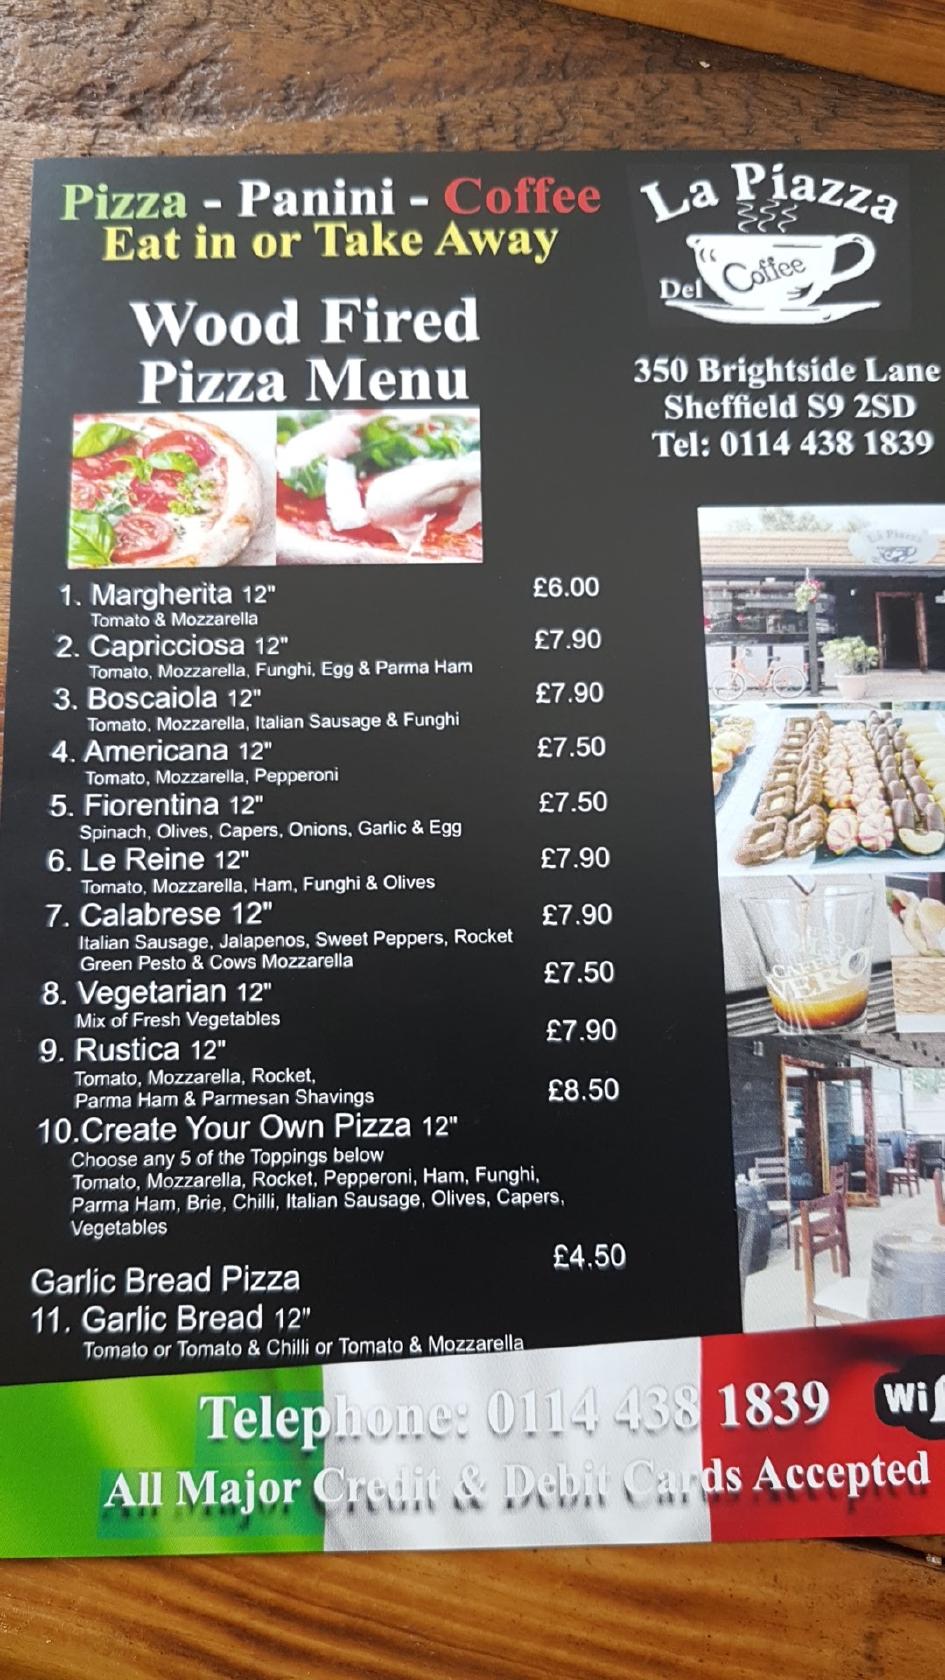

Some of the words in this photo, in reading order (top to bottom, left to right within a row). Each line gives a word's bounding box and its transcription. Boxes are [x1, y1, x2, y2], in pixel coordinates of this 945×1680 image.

[60, 180, 188, 221] Pizza
[238, 178, 395, 217] Panini
[444, 176, 602, 215] Coffee
[640, 179, 720, 224] La
[730, 162, 899, 225] Piazza
[102, 224, 180, 261] Eat
[194, 222, 237, 259] in
[252, 231, 301, 259] or
[314, 221, 423, 258] Take
[435, 220, 559, 264] Away
[722, 256, 807, 293] Coffee
[659, 278, 704, 299] Del
[129, 297, 301, 347] Wood
[320, 294, 480, 344] Fired
[138, 359, 288, 405] Pizza
[305, 357, 469, 402] Menu
[633, 357, 689, 383] 350
[697, 355, 857, 389] Brightside
[864, 356, 942, 383] Lane
[663, 394, 799, 420] Sheffield
[807, 394, 846, 419] S9
[853, 394, 918, 419] 2SD
[651, 430, 711, 458] Tel:
[719, 430, 792, 457] 0114
[799, 429, 855, 456] 438
[863, 429, 936, 456] 1839
[90, 580, 233, 611] Margherita
[533, 576, 600, 598] £6.00
[89, 612, 151, 628] Tomato
[170, 610, 259, 627] Mozzarella
[54, 634, 80, 659] 2.
[87, 632, 245, 662] Capricciosa
[534, 628, 602, 650] £7.90
[87, 663, 153, 681] Tomato,
[156, 662, 250, 679] Mozzarella,
[255, 661, 316, 681] Funghi,
[320, 660, 354, 680] Egg
[374, 659, 430, 676] Parma
[433, 658, 473, 675] Ham
[86, 684, 218, 711] Boscaiola
[535, 682, 604, 704] £7.90
[85, 716, 152, 733] Tomato,
[156, 715, 250, 732] Mozzarella,
[254, 714, 305, 730] Italian
[308, 712, 382, 732] Sausage
[403, 710, 460, 731] Funghi
[80, 738, 229, 763] Americana
[537, 735, 607, 758] £7.50
[84, 770, 151, 787] Tomato,
[154, 768, 249, 786] Mozzarella,
[253, 766, 339, 787] Pepperoni
[47, 793, 74, 818] 5.
[83, 791, 220, 817] Fiorentina
[539, 790, 608, 814] £7.50
[79, 823, 152, 844] Spinach,
[155, 822, 214, 840] Olives,
[216, 821, 284, 842] Capers,
[287, 821, 353, 838] Onions,
[357, 819, 408, 837] Garlic
[429, 818, 463, 838] Egg
[80, 847, 117, 872] Le
[123, 846, 206, 872] Reine
[540, 846, 611, 869] £7.90
[79, 878, 148, 896] Tomato,
[150, 877, 248, 895] Mozzarella,
[252, 876, 298, 894] Ham,
[302, 875, 361, 895] Funghi
[382, 874, 436, 891] Olives
[44, 903, 70, 928] 7.
[78, 901, 222, 928] Calabrese
[542, 903, 613, 926] £7.90
[78, 934, 130, 951] Italian
[133, 933, 214, 954] Sausage,
[218, 932, 310, 952] Jalapenos,
[314, 930, 369, 948] Sweet
[373, 929, 449, 950] Peppers,
[453, 927, 514, 945] Rocket
[79, 955, 133, 972] Green
[136, 954, 187, 971] Pesto
[207, 953, 257, 971] Cows
[260, 952, 354, 970] Mozzarella
[543, 960, 616, 984] £7.50
[75, 977, 227, 1010] Vegetarian
[74, 1012, 107, 1029] Mix
[109, 1011, 129, 1029] of
[130, 1011, 181, 1028] Fresh
[184, 1010, 281, 1032] Vegetables
[546, 1018, 618, 1042] £7.90
[73, 1035, 180, 1063] Rustica
[73, 1070, 142, 1089] Tomato,
[146, 1067, 246, 1086] Mozzarella,
[250, 1066, 316, 1085] Rocket,
[548, 1077, 620, 1102] £8.50
[73, 1092, 132, 1110] Parma
[136, 1091, 179, 1109] Ham
[200, 1089, 290, 1107] Parmesan
[294, 1087, 375, 1108] Shavings
[184, 1114, 252, 1142] Your
[258, 1113, 325, 1141] Own
[334, 1111, 412, 1139] Pizza
[69, 1151, 138, 1169] Choose
[142, 1153, 176, 1172] any
[179, 1149, 192, 1167] 5
[194, 1148, 215, 1167] of
[217, 1148, 246, 1167] the
[249, 1147, 329, 1169] Toppings
[332, 1146, 385, 1164] below
[71, 1173, 141, 1192] Tomato,
[145, 1171, 246, 1191] Mozzarella,
[251, 1170, 318, 1188] Rocket,
[323, 1167, 418, 1190] Pepperoni,
[423, 1167, 470, 1186] Ham,
[475, 1164, 540, 1188] Funghi,
[70, 1196, 130, 1215] Parma
[134, 1194, 181, 1214] Ham,
[185, 1193, 227, 1213] Brie,
[232, 1192, 280, 1212] Chilli,
[285, 1191, 338, 1210] Italian
[343, 1190, 426, 1212] Sausage,
[430, 1189, 491, 1209] Olives,
[496, 1187, 565, 1209] Capers,
[69, 1218, 168, 1241] Vegetables
[553, 1243, 627, 1270] £4.50
[30, 1267, 117, 1297] Garlic
[124, 1264, 212, 1296] Bread
[221, 1264, 301, 1293] Pizza
[31, 1305, 71, 1334] 11.
[80, 1304, 168, 1335] Garlic
[176, 1302, 263, 1333] Bread
[82, 1340, 149, 1361] Tomato
[152, 1344, 173, 1360] or
[176, 1339, 243, 1359] Tomato
[266, 1337, 310, 1358] Chilli
[314, 1340, 334, 1357] or
[337, 1336, 404, 1356] Tomato
[428, 1333, 525, 1355] Mozzarella
[199, 1393, 470, 1451] Telephone:
[486, 1386, 600, 1435] 0114
[614, 1384, 699, 1431] 438
[718, 1379, 831, 1428] 1839
[103, 1471, 163, 1508] All
[176, 1468, 302, 1514] Major
[313, 1466, 441, 1504] Credit
[505, 1457, 608, 1500] Debit
[623, 1457, 743, 1497] Cards
[752, 1450, 932, 1499] Accepted
